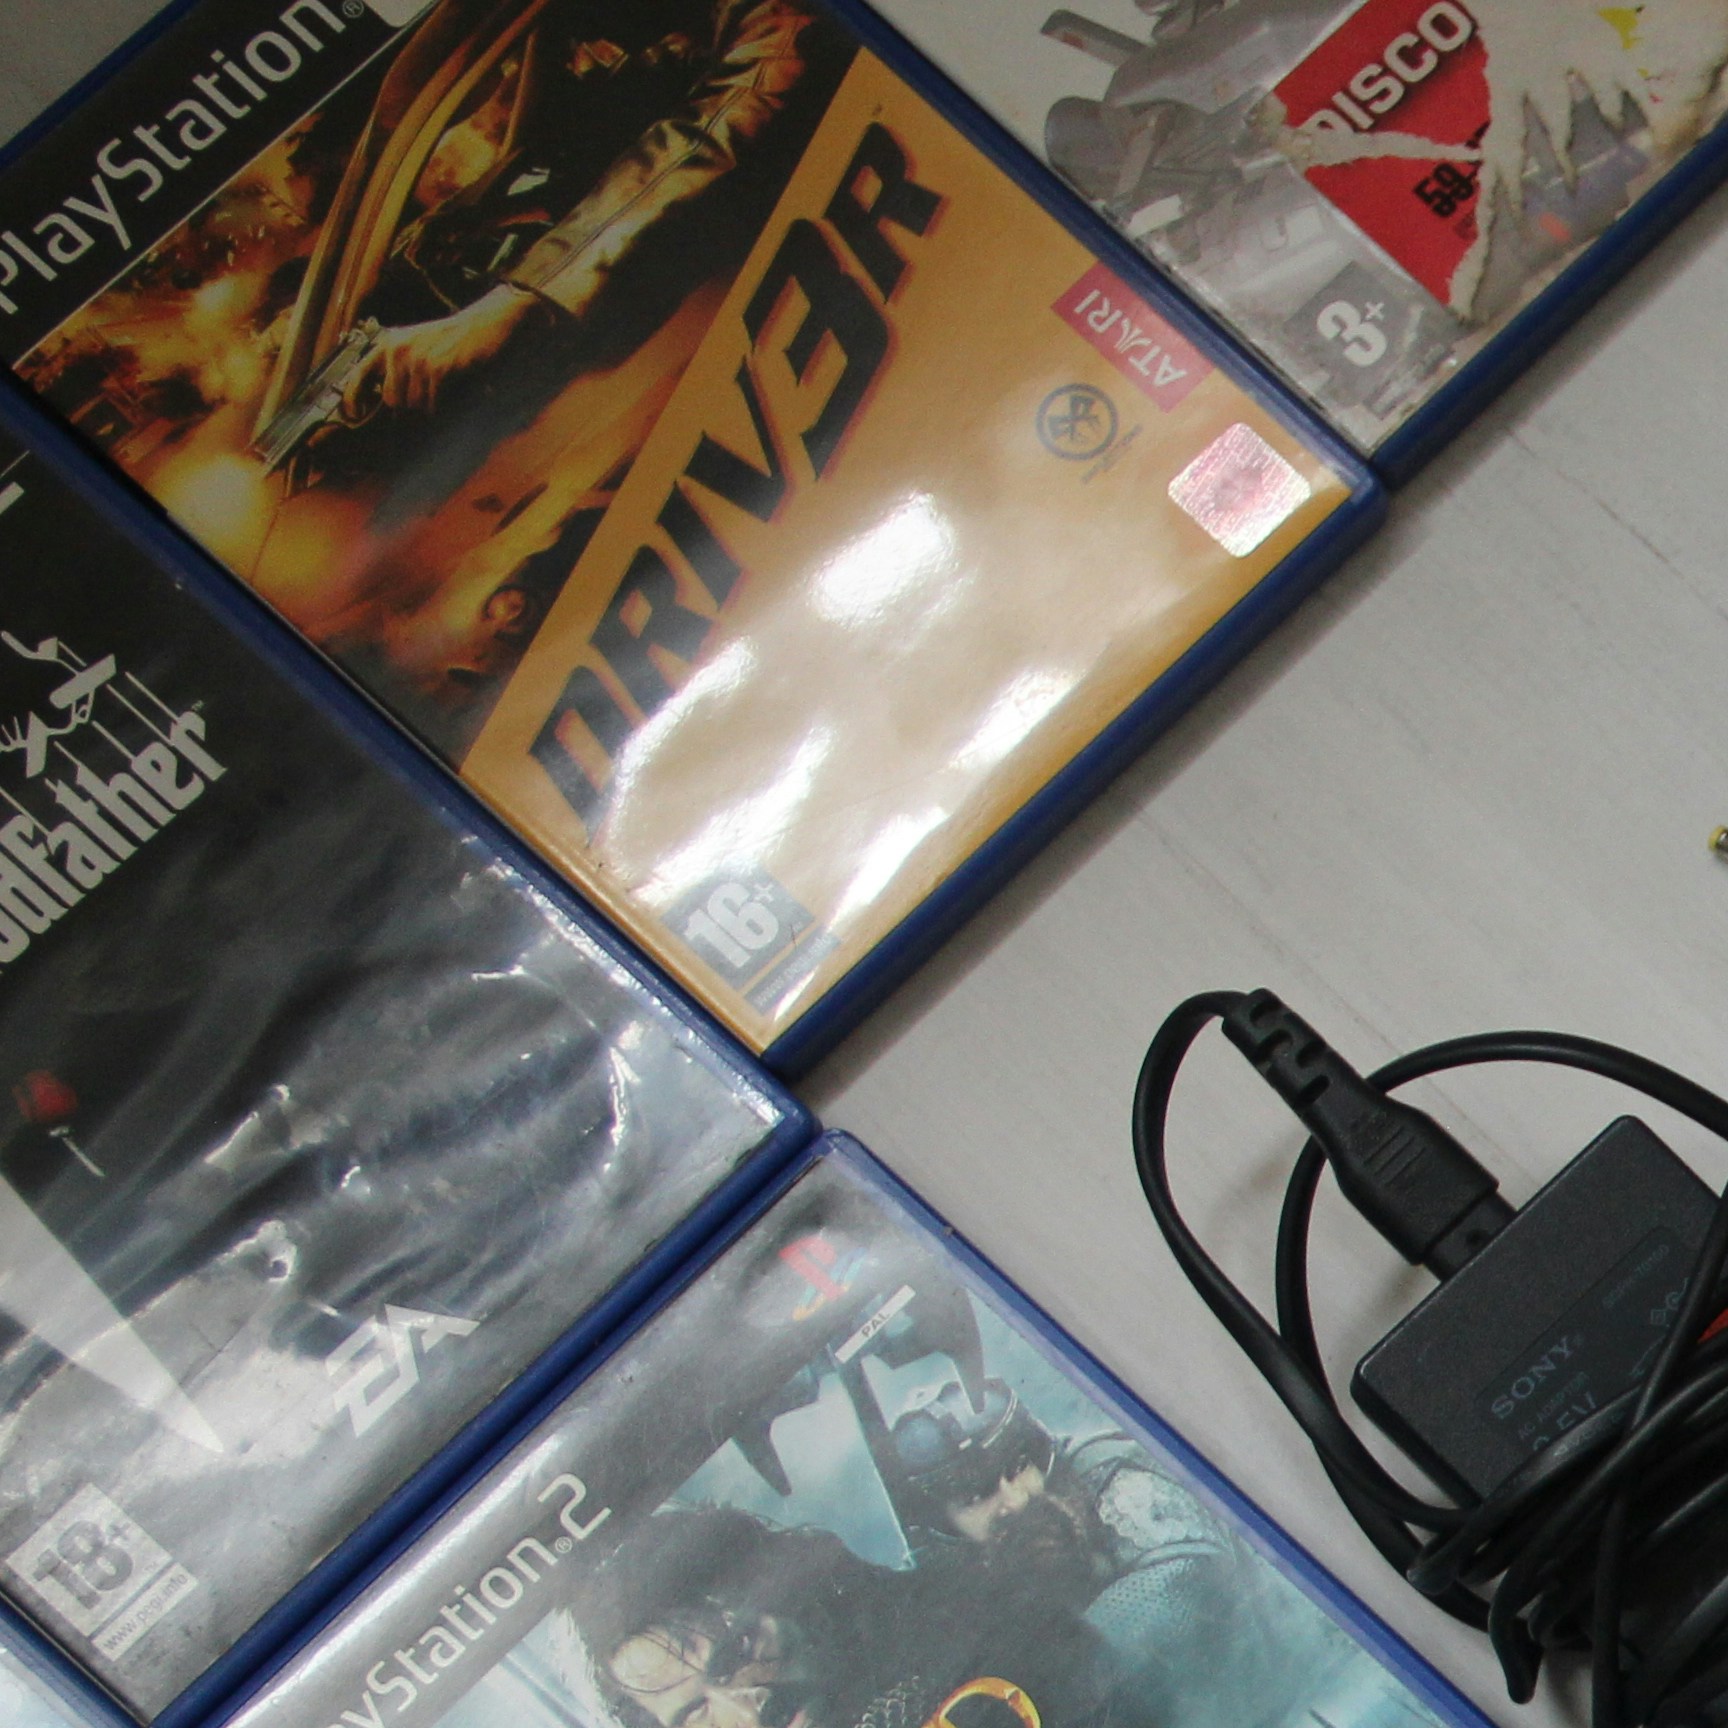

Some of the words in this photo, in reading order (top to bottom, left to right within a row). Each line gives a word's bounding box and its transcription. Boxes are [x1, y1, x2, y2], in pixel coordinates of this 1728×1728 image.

[1072, 289, 1187, 391] ATARI
[684, 880, 777, 969] 16+
[326, 1303, 481, 1438] EA
[1491, 1335, 1575, 1423] SONY
[32, 1519, 133, 1611] 18+
[103, 1569, 190, 1653] www.pegi.info
